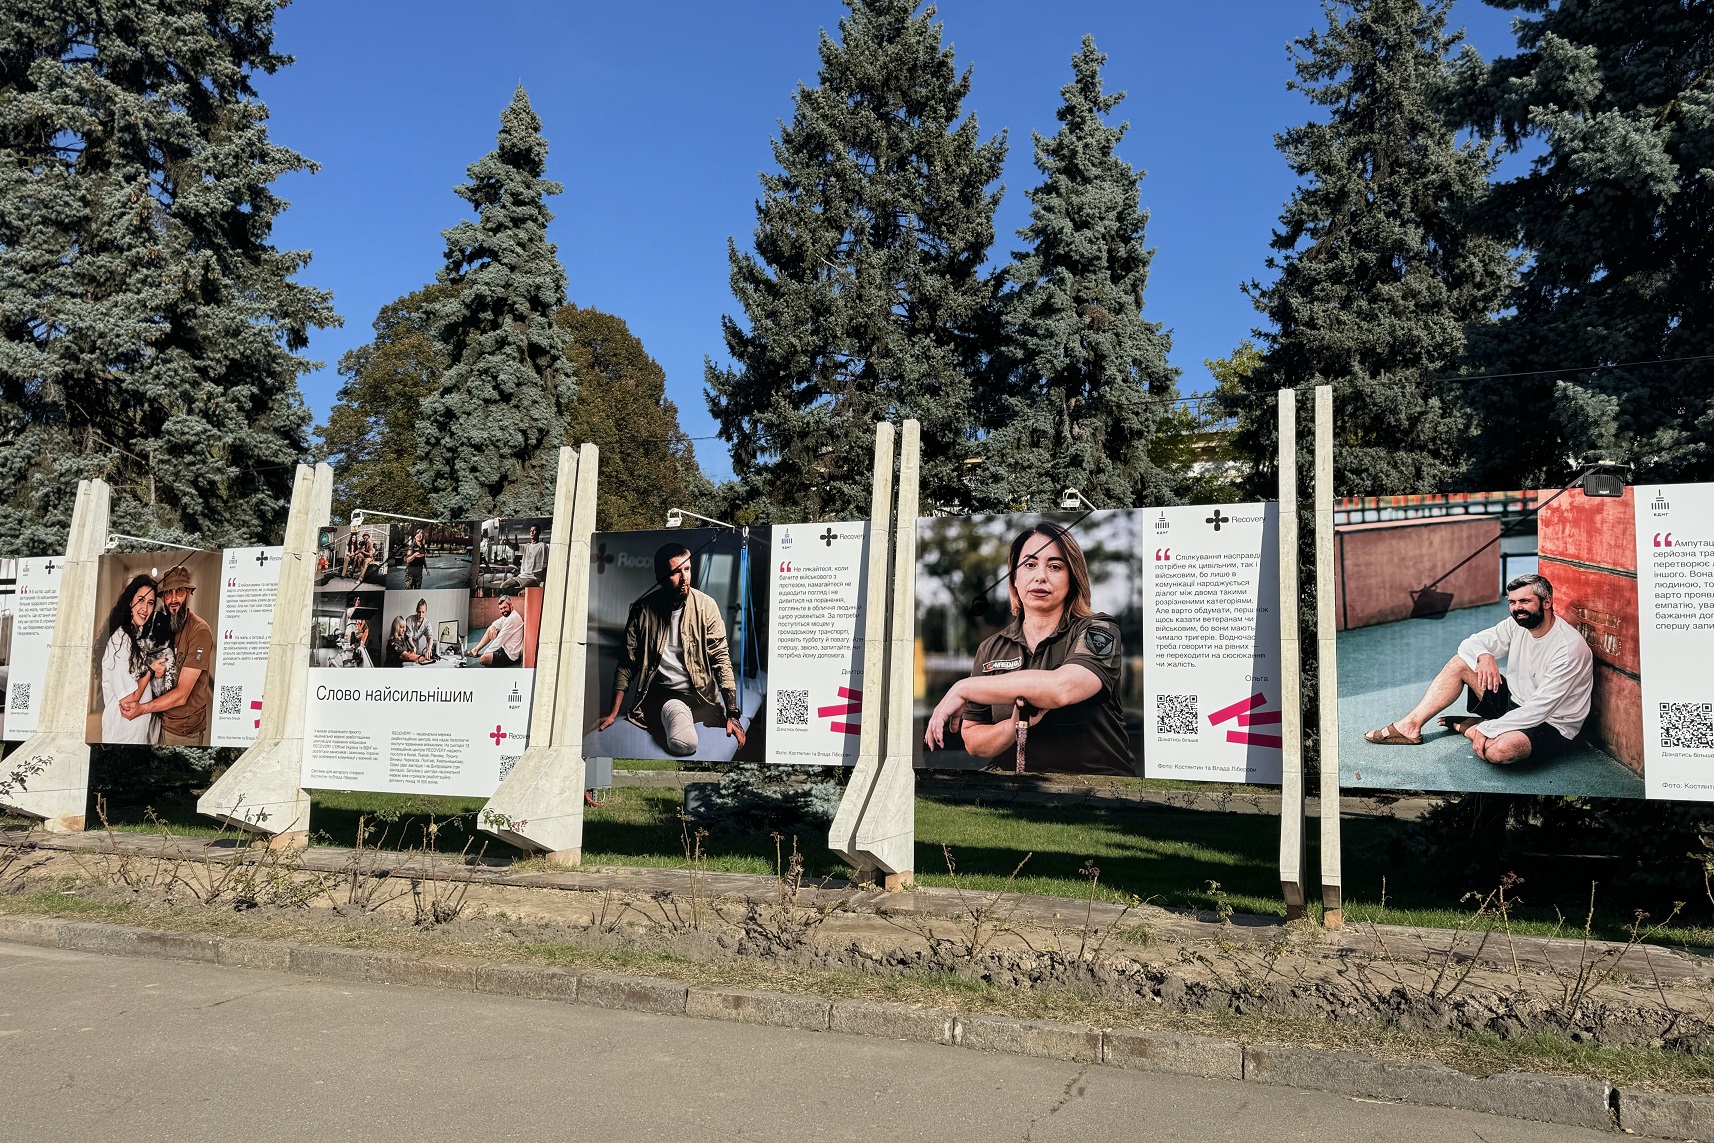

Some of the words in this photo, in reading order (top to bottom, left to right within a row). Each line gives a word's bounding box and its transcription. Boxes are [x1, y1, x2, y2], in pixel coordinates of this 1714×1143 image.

[1675, 540, 1714, 548] Ампутац
[1653, 550, 1696, 559] серйозна
[317, 685, 360, 701] Слово
[366, 687, 473, 702] найсильнішим
